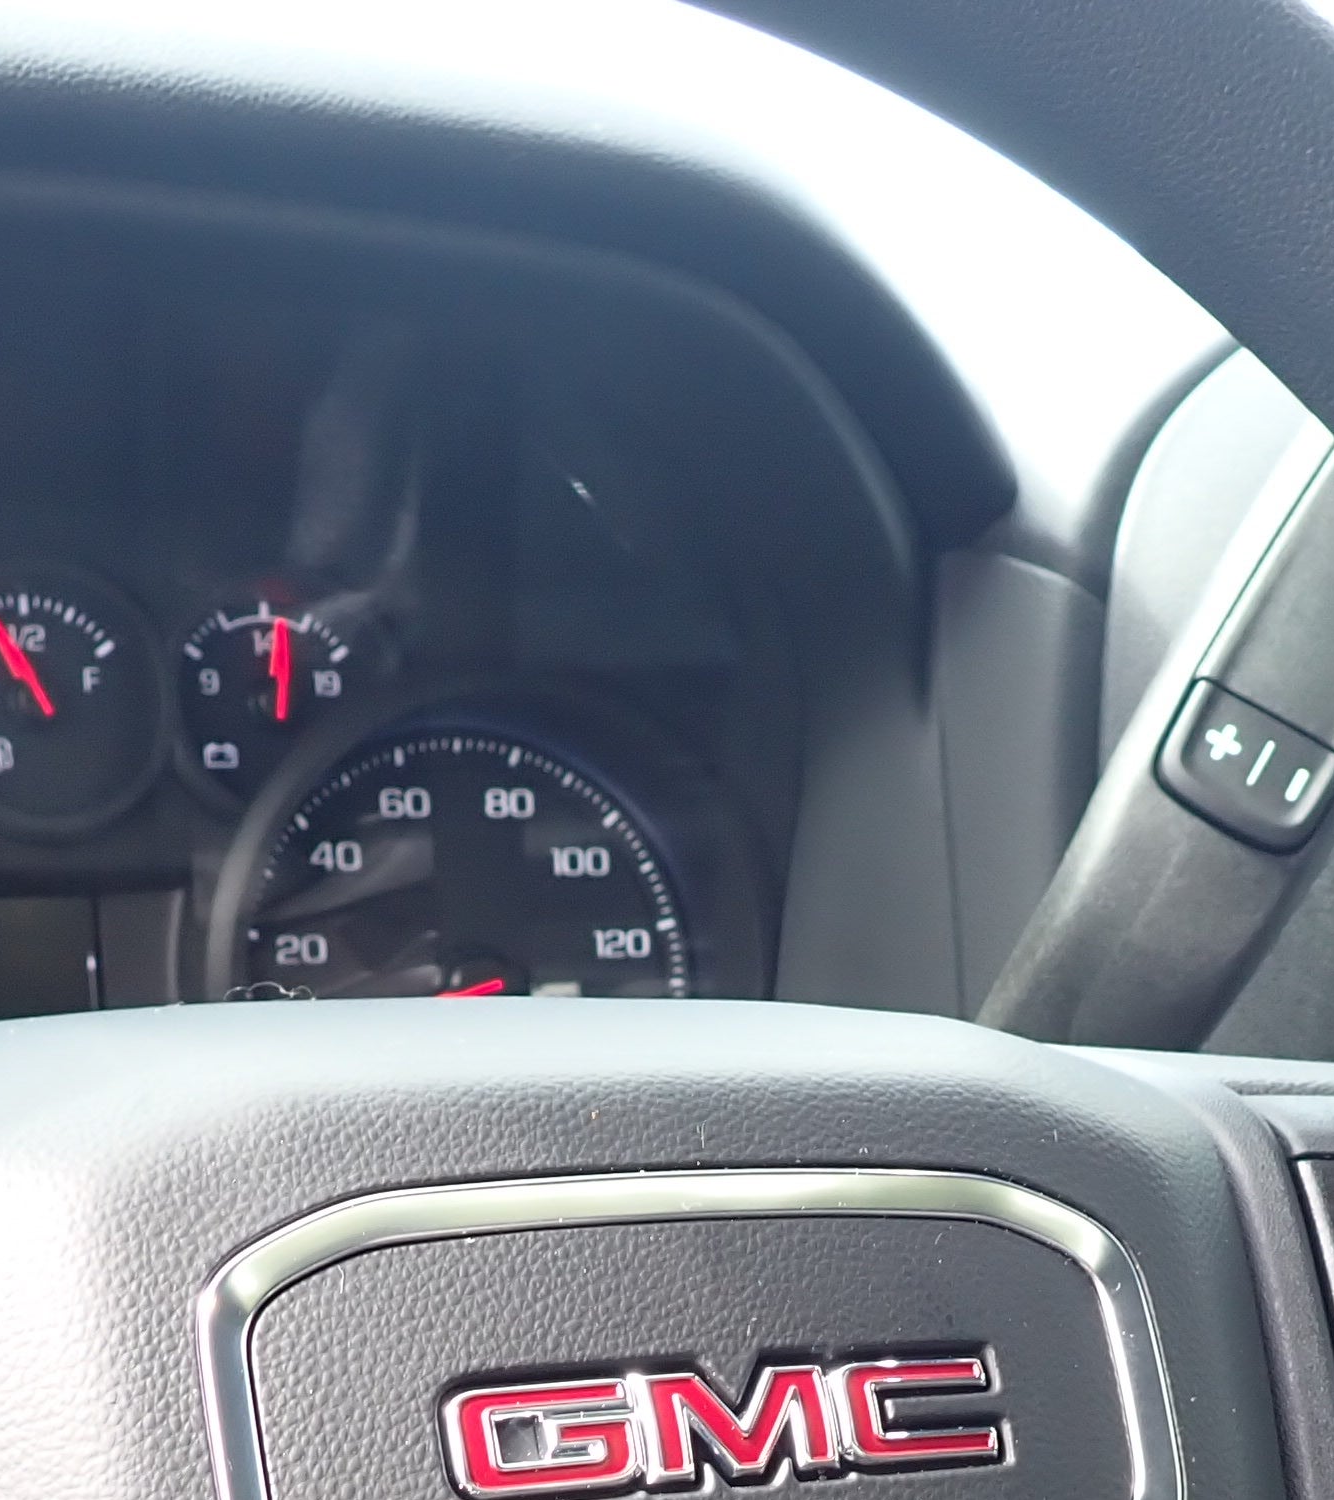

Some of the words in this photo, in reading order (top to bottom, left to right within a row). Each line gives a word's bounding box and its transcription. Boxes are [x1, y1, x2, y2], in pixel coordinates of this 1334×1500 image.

[82, 666, 101, 694] F
[199, 668, 221, 696] 9
[312, 669, 342, 699] 19
[378, 787, 431, 819] 60
[484, 788, 536, 819] 80
[309, 841, 364, 872] 40
[550, 846, 611, 877] 100
[274, 933, 329, 965] 20
[593, 928, 651, 958] 120
[445, 1357, 1002, 1494] GMC
